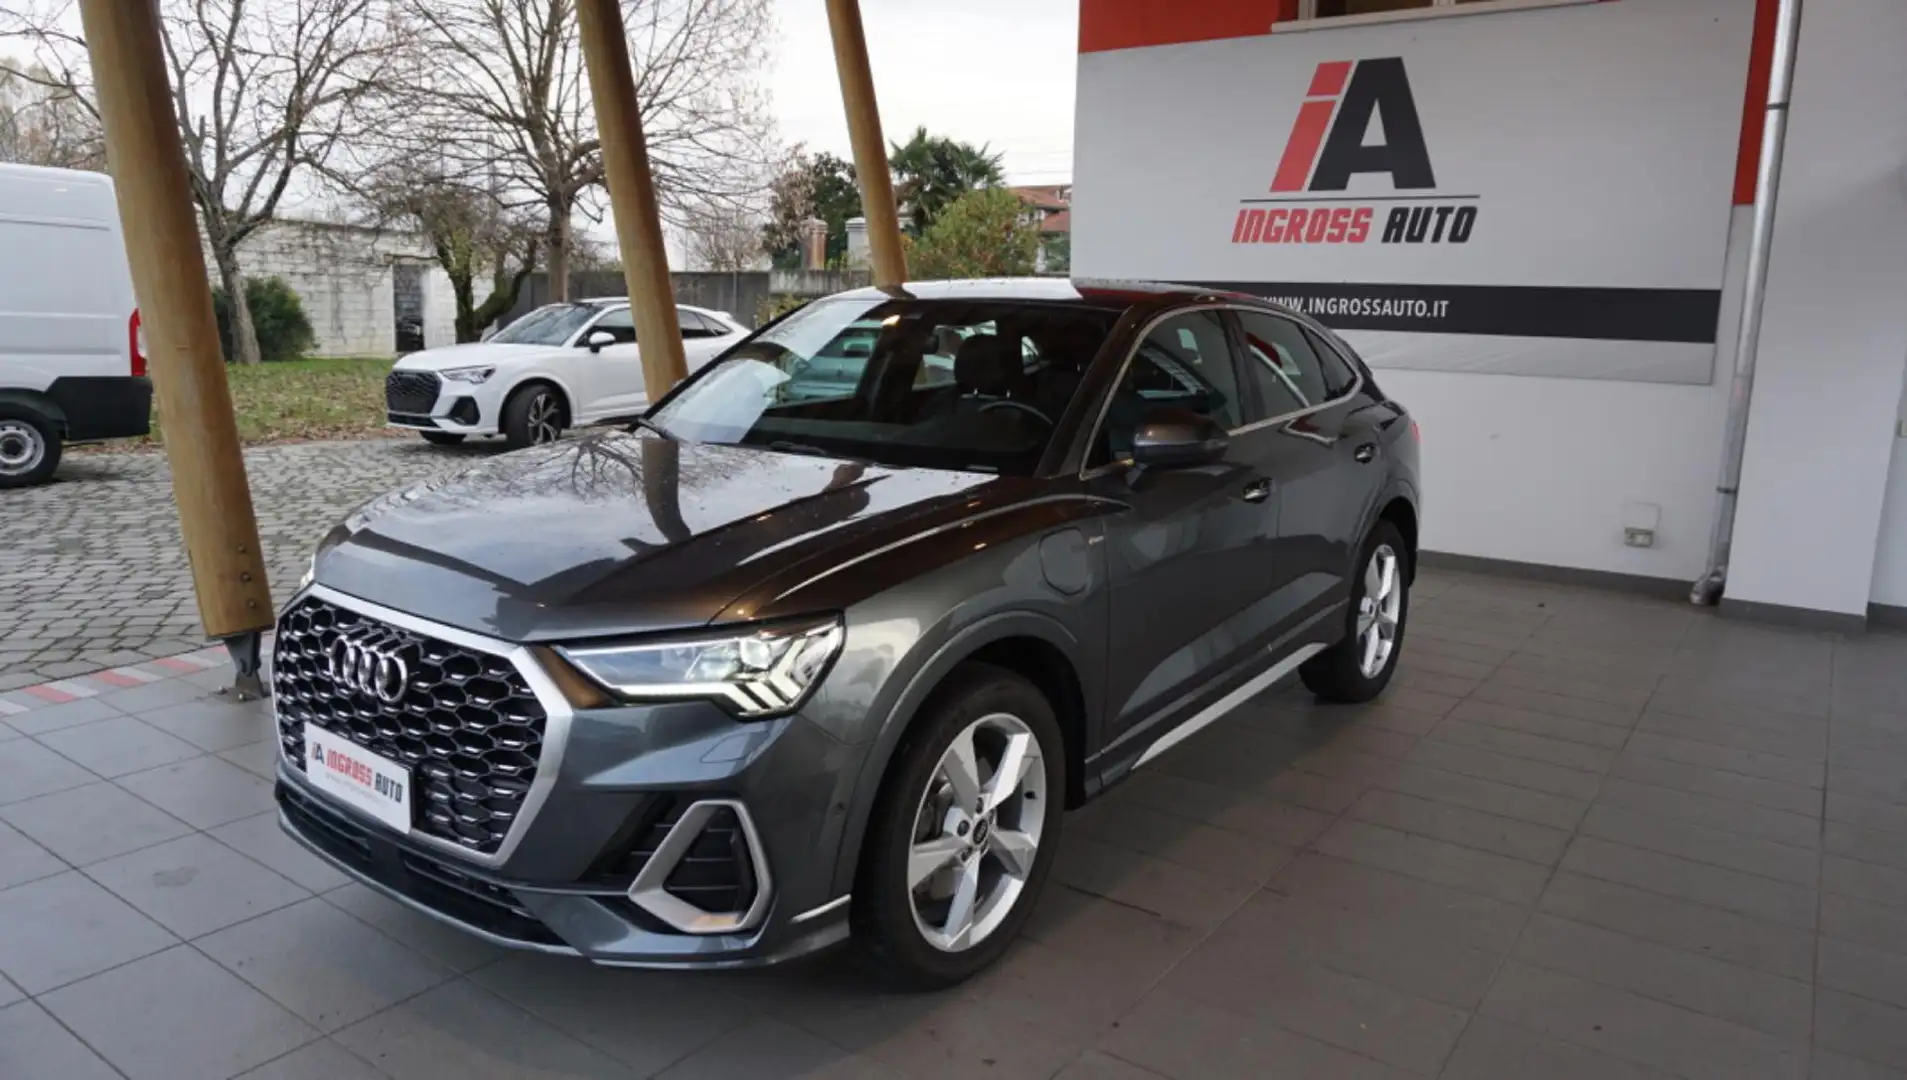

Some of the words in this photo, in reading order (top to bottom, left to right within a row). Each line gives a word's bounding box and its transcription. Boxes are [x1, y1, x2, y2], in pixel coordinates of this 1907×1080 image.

[1231, 208, 1374, 244] INGROSS
[1381, 206, 1478, 244] AUTO
[1263, 296, 1449, 318] W.INGROSSAUTO.IT
[327, 749, 373, 787] INGROSS
[374, 772, 403, 804] AUTO
